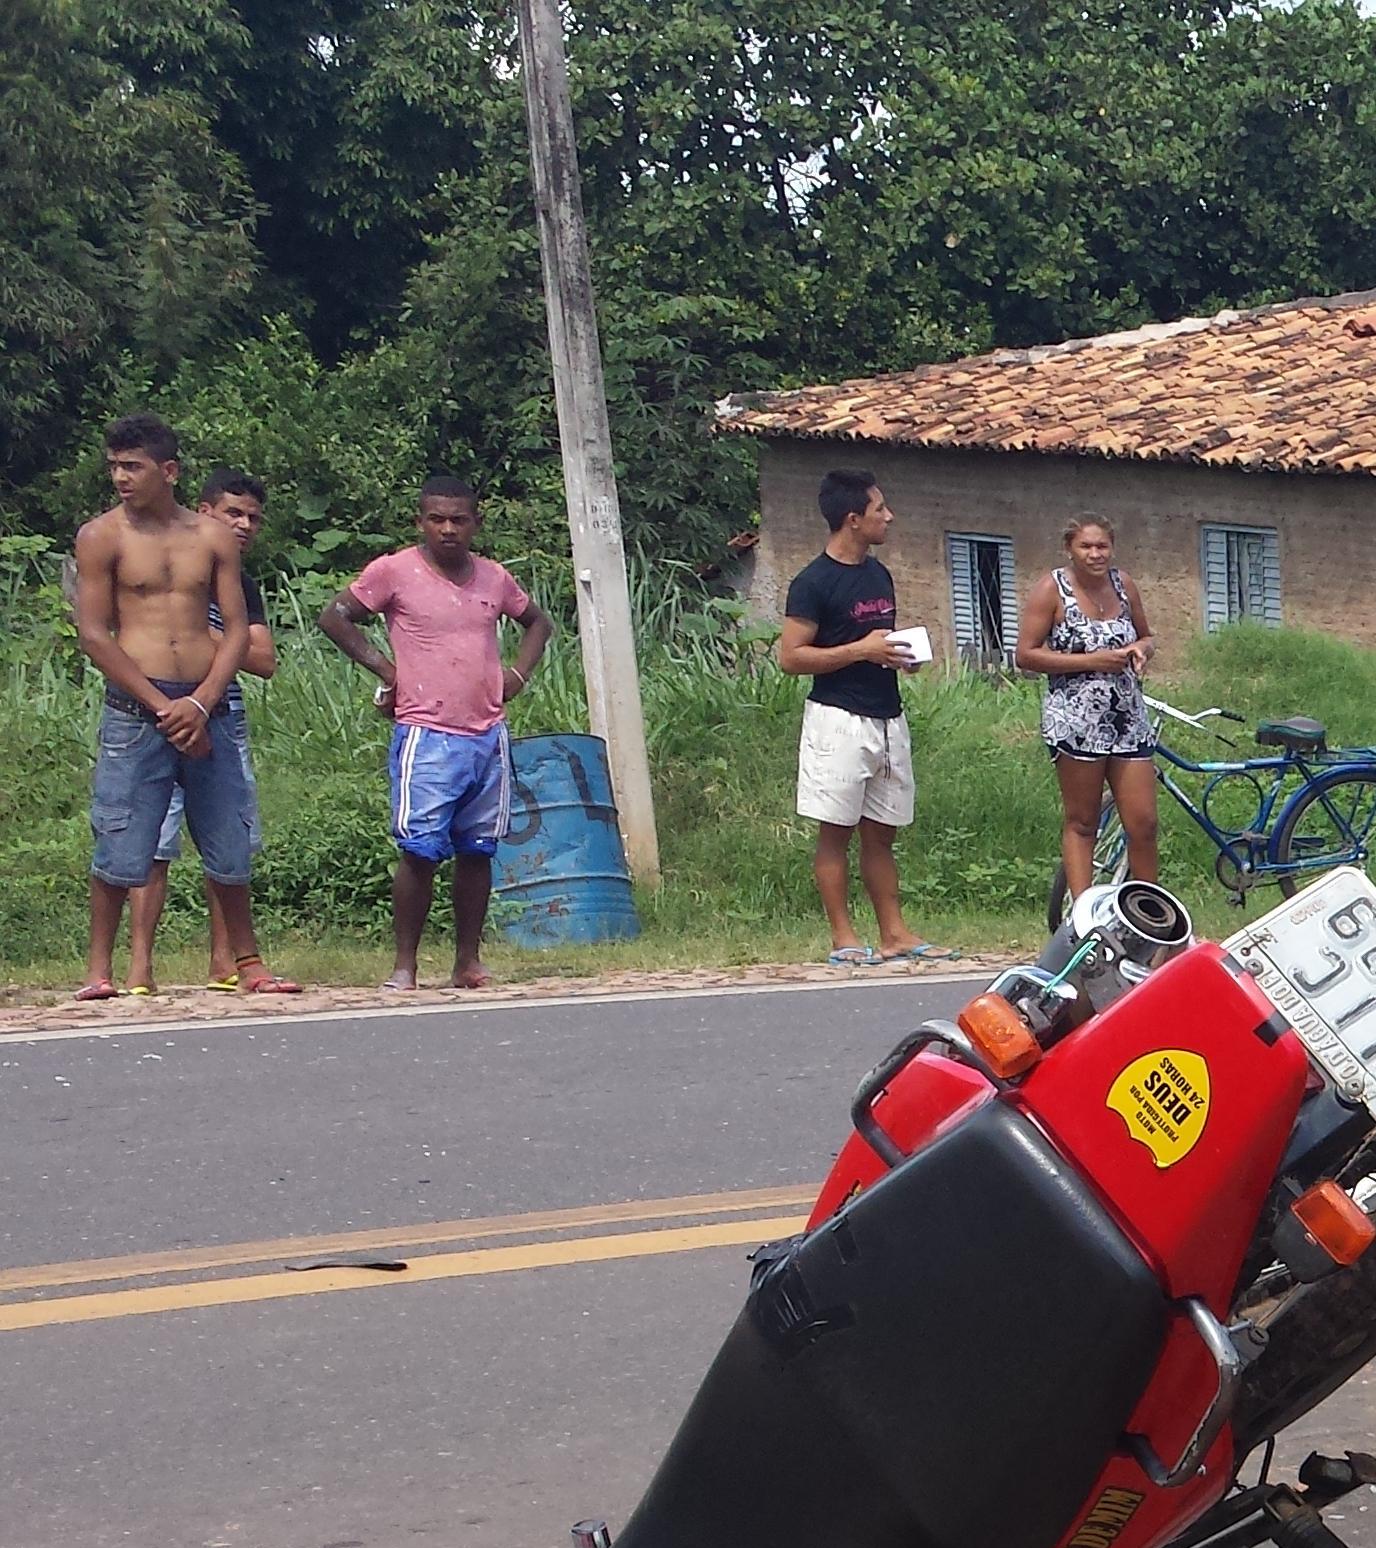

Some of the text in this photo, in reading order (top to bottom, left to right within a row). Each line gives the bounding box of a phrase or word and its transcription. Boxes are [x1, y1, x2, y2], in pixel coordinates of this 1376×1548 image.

[1129, 1084, 1145, 1104] POR
[1144, 1070, 1192, 1126] DEUS
[1159, 1056, 1206, 1109] 24 HORAS
[1135, 1110, 1157, 1135] MOTO
[1088, 1487, 1145, 1530] MIM
